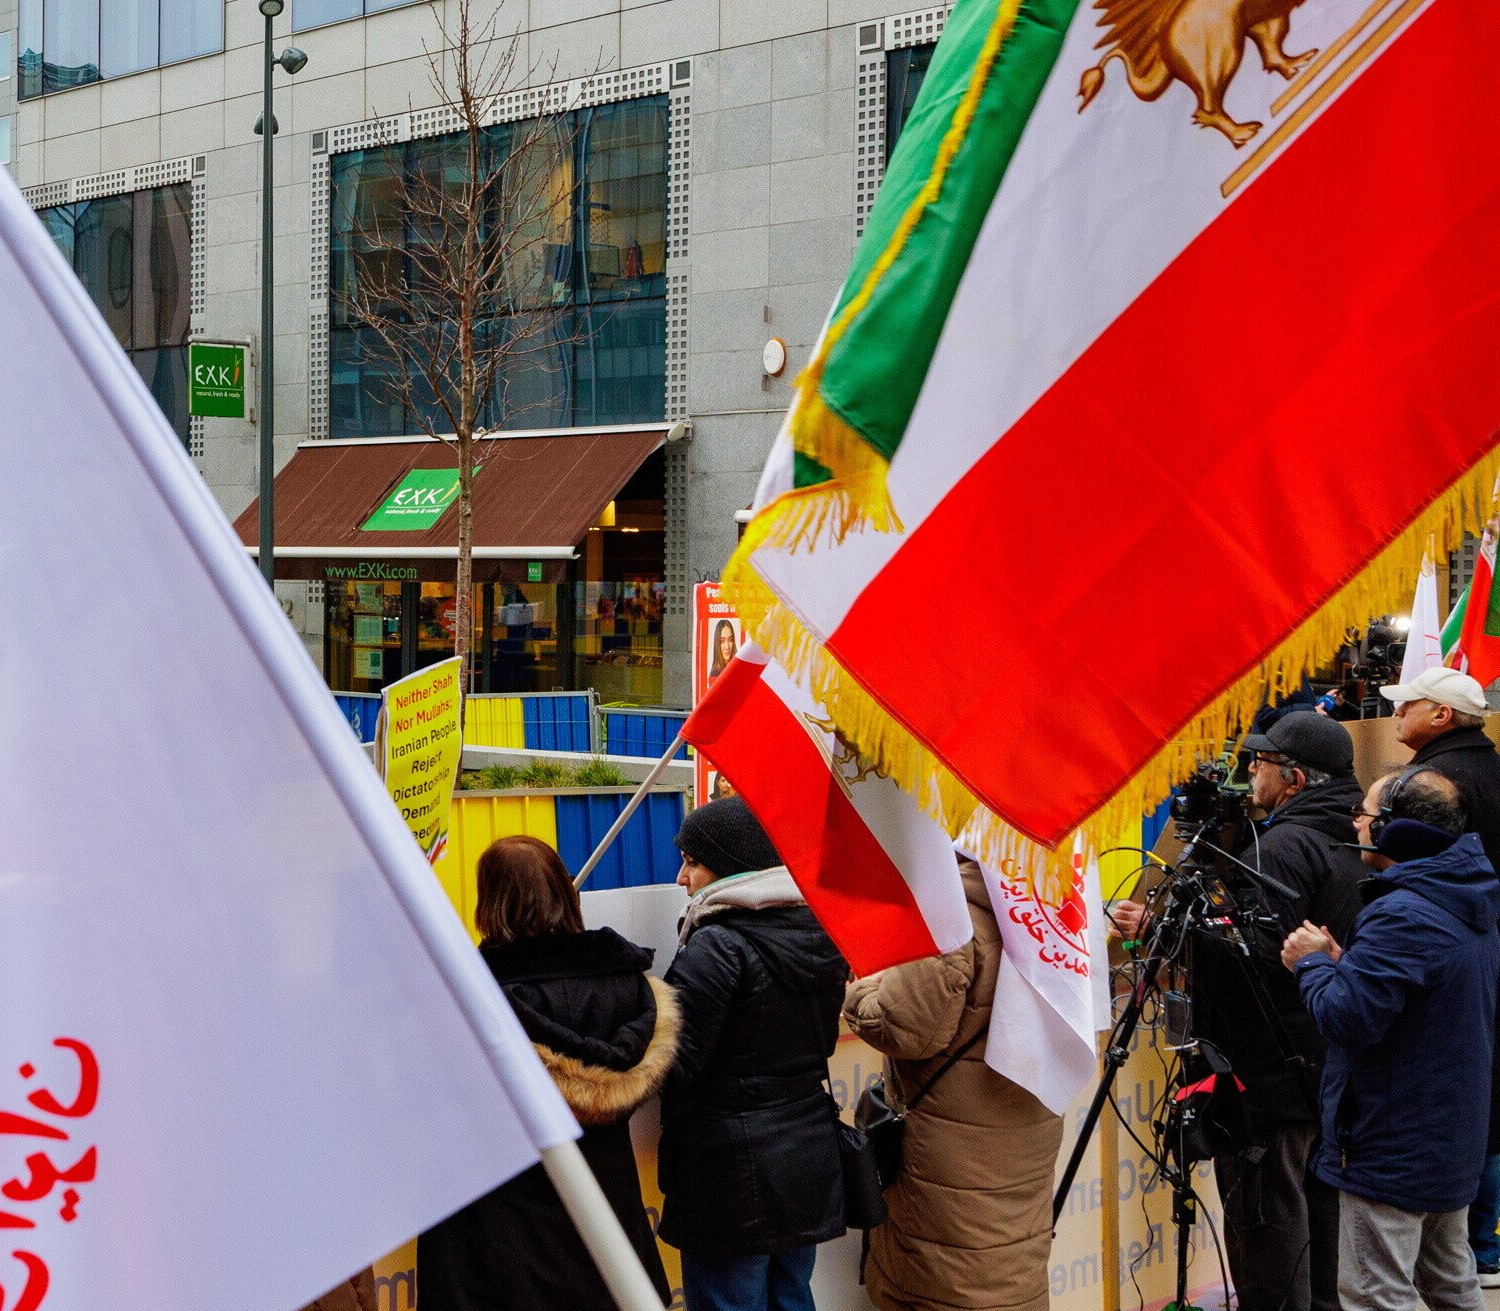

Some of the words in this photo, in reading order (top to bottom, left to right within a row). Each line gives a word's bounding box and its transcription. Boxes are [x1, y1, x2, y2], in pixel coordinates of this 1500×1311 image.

[325, 562, 418, 579] www.EXKi.com
[396, 686, 432, 711] Neither
[433, 674, 453, 696] Shah
[395, 716, 413, 735] Nor
[416, 699, 453, 727] Mullahs:
[392, 736, 428, 760] Iranian
[430, 718, 457, 745] People
[411, 750, 442, 775] Reject
[393, 766, 450, 803] Dictatorship
